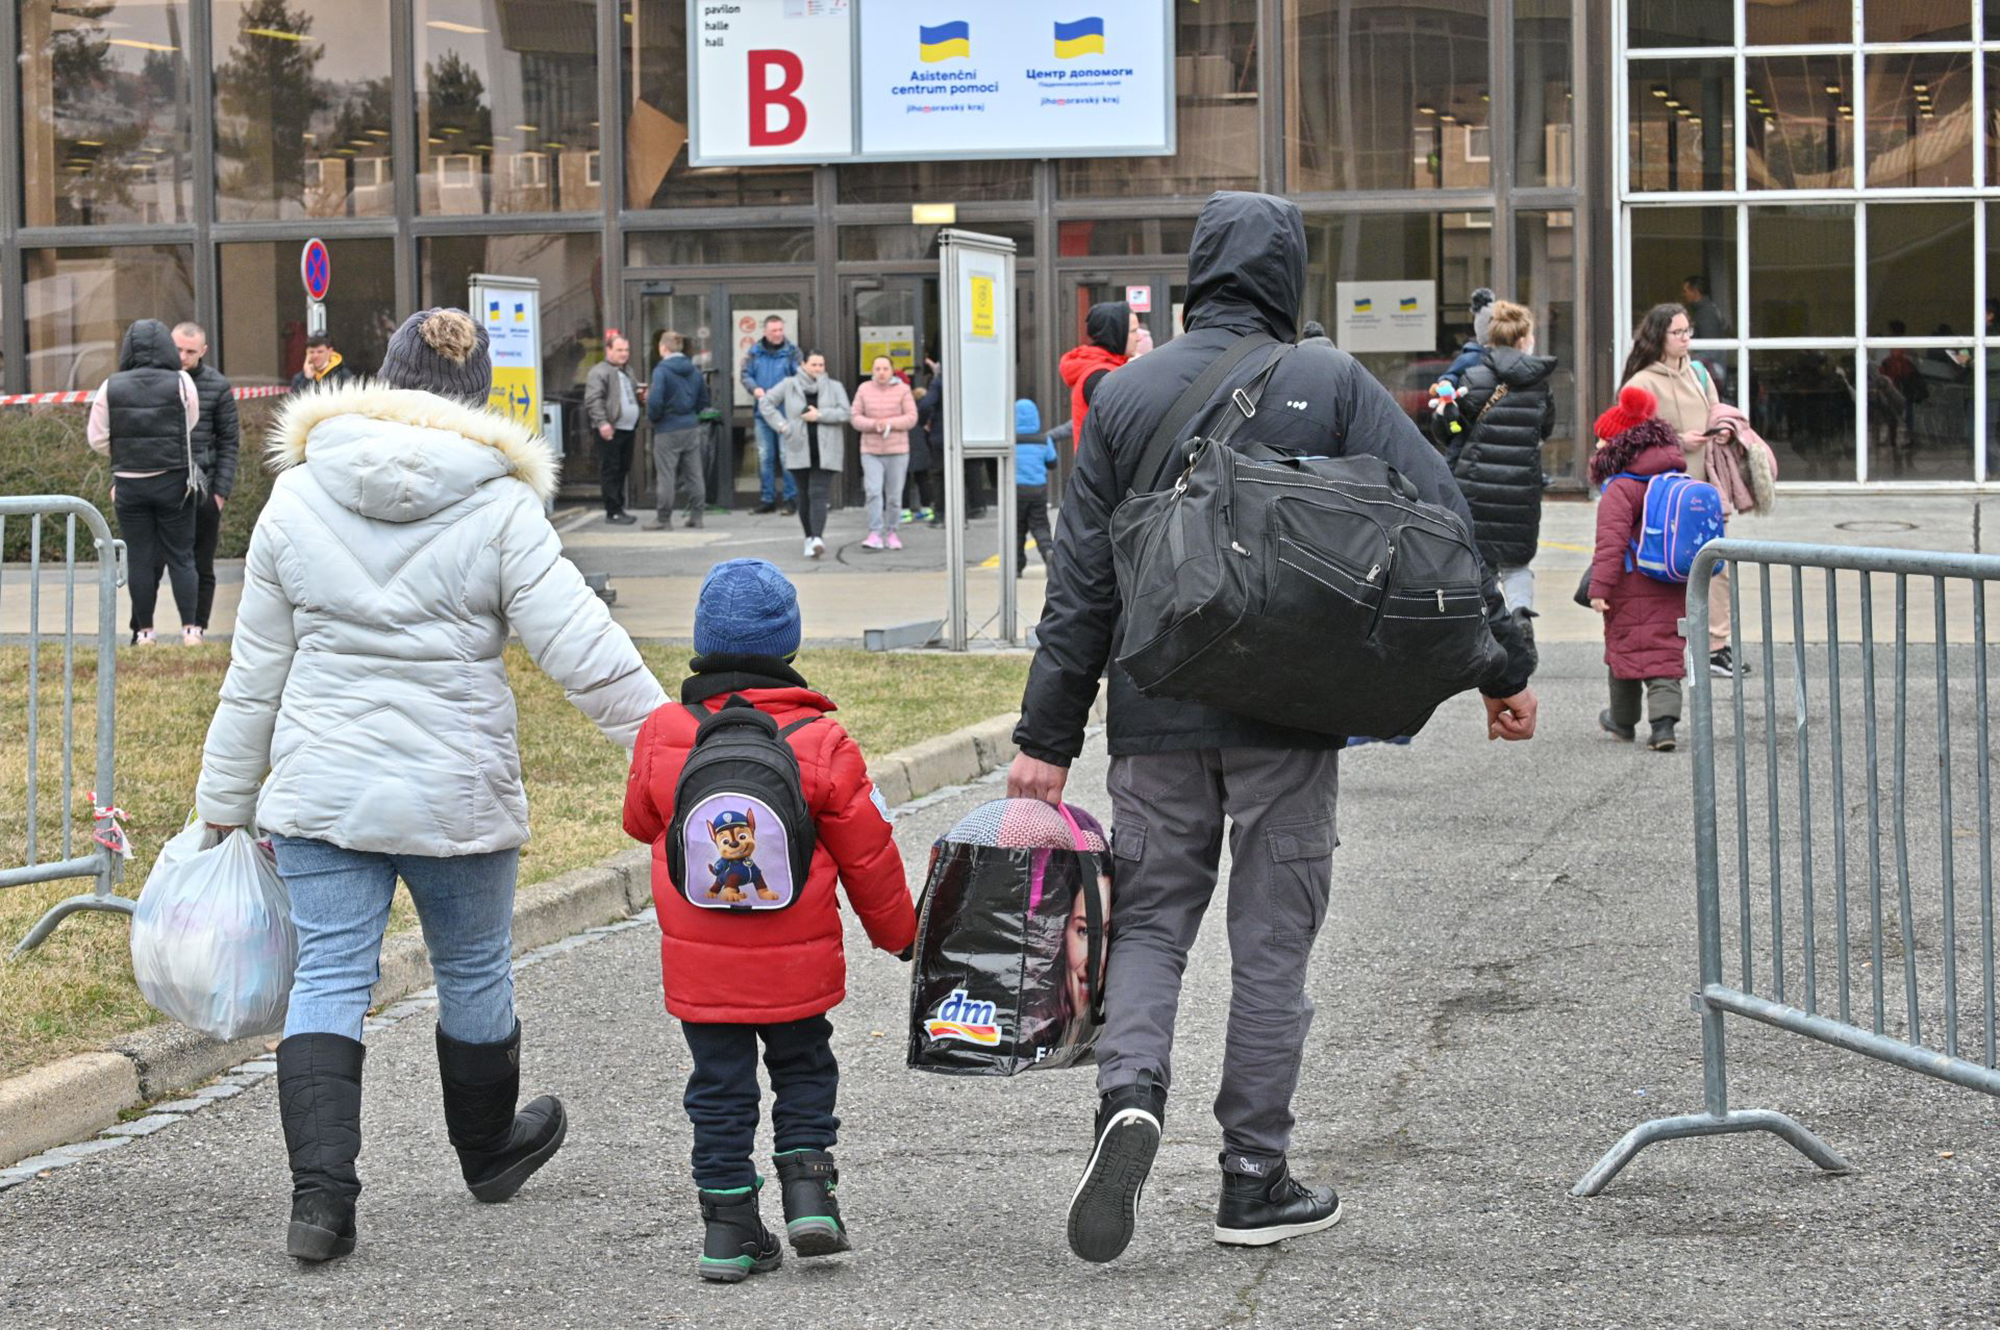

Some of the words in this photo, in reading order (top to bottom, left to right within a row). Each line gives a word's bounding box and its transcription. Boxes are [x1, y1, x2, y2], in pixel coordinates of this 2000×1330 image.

[704, 4, 741, 16] pavilon
[704, 21, 729, 31] halle
[704, 37, 724, 47] hall
[1026, 69, 1066, 80] Центр
[1070, 68, 1133, 79] допомоги
[891, 84, 947, 96] centrum
[950, 81, 999, 96] pomoci
[747, 49, 808, 147] B
[941, 993, 993, 1025] dm
